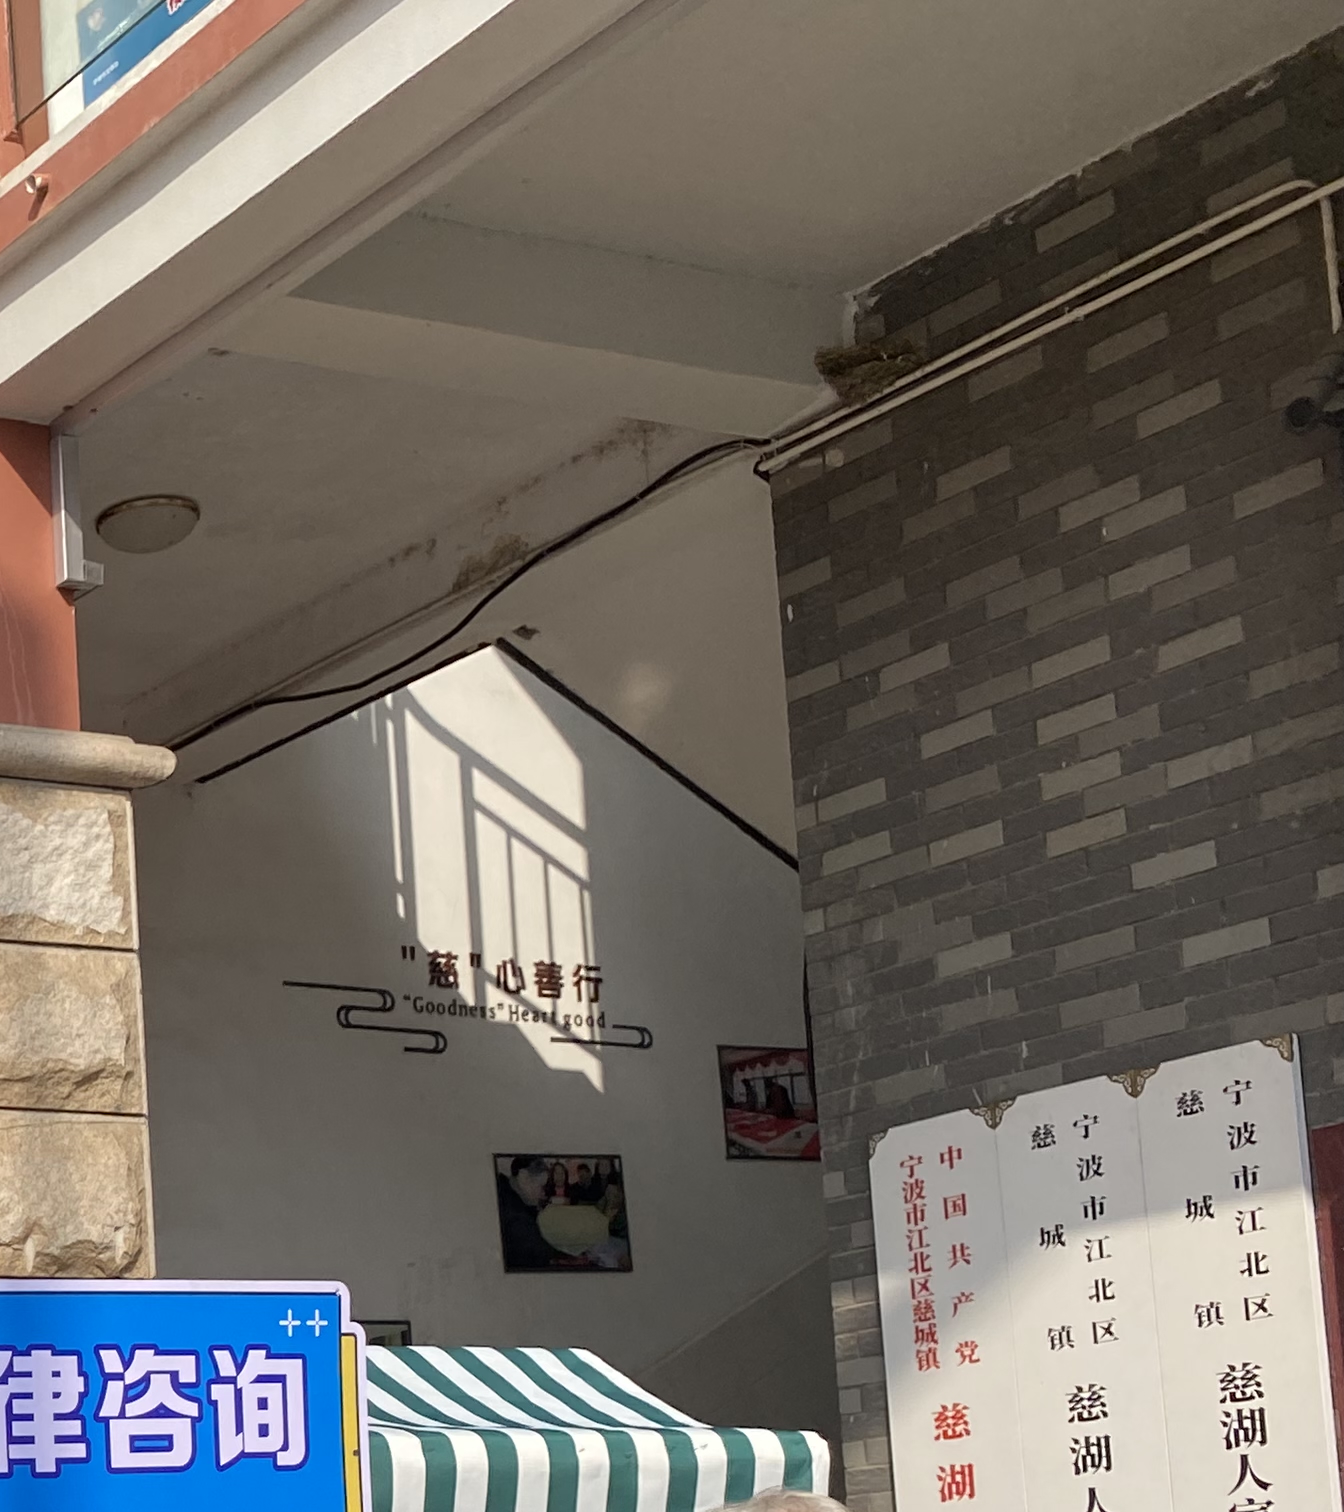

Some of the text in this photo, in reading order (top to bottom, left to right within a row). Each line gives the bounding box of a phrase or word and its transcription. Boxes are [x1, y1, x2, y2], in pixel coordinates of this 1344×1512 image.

[899, 1155, 941, 1372] 宁波市江北区慈城镇
[939, 1145, 981, 1366] 中国共产党
[1072, 1114, 1120, 1345] 宁波市江北区
[1222, 1079, 1274, 1321] 宁波市江北区
